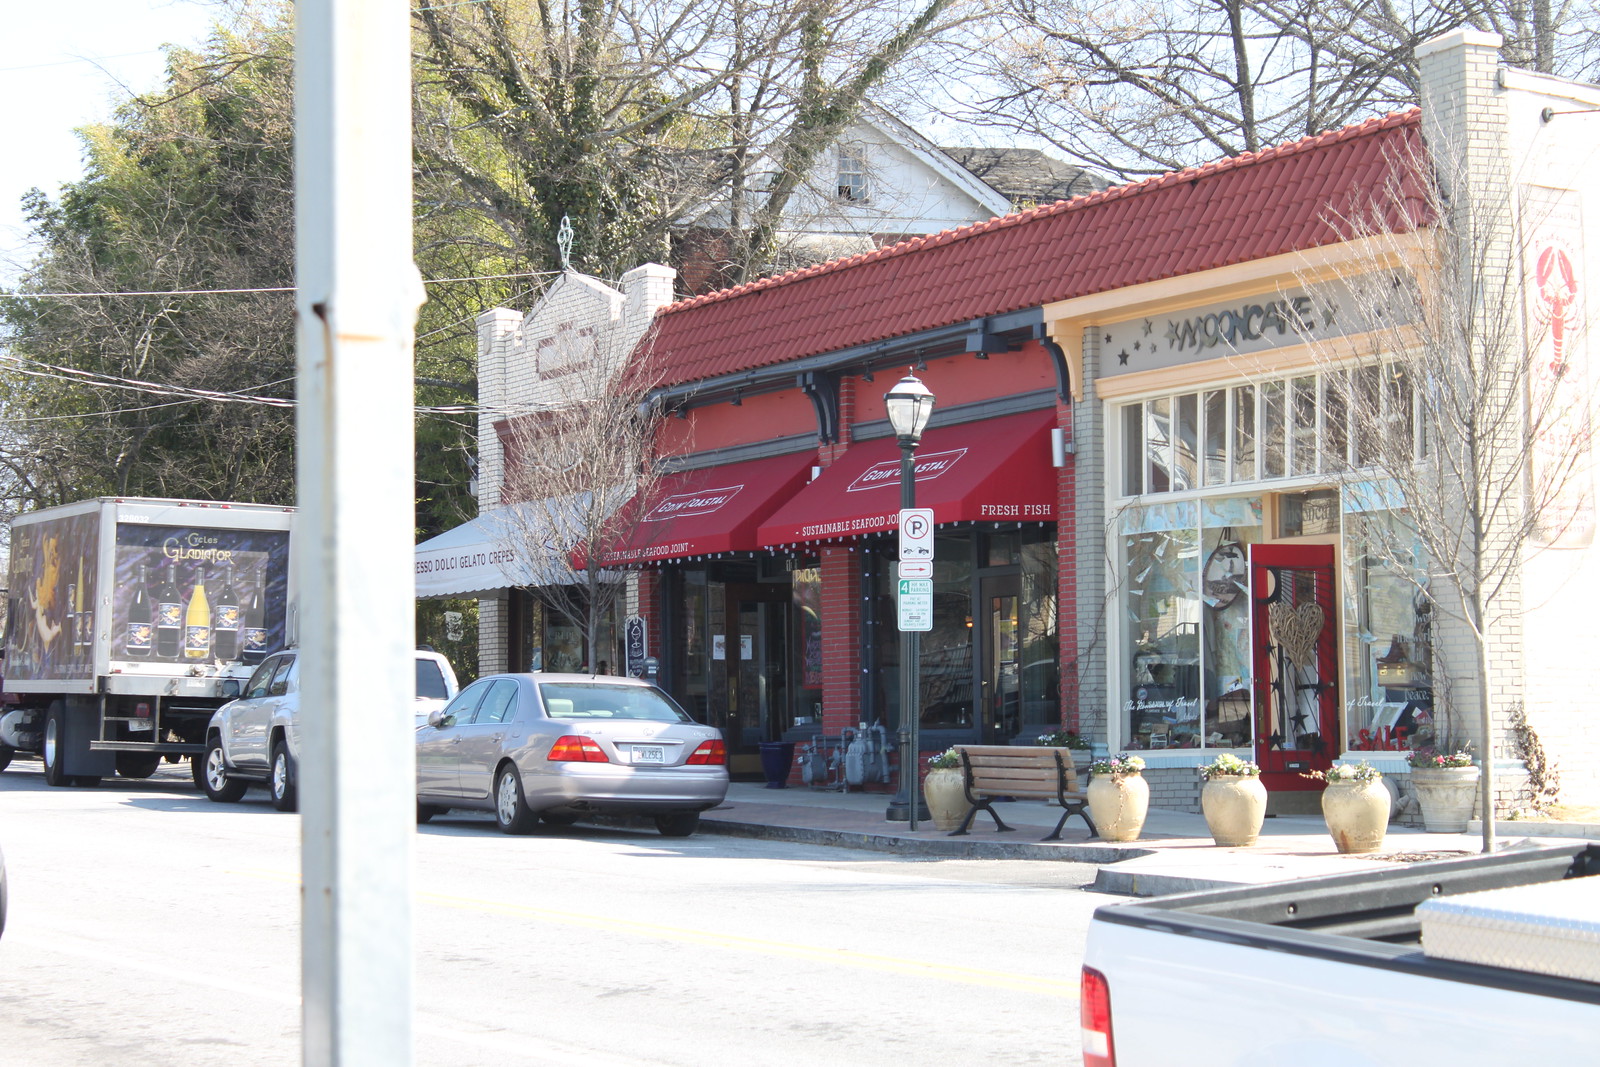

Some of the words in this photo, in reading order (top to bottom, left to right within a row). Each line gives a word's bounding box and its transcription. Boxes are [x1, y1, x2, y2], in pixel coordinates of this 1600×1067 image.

[893, 459, 949, 477] CASTAL
[981, 504, 1018, 516] FRESH
[1024, 504, 1051, 515] FISH
[802, 520, 850, 537] SUSTAINABLE
[851, 516, 885, 530] SEAFOOD
[886, 513, 899, 525] JOI
[670, 543, 689, 554] JOINT
[416, 561, 433, 574] ESSO
[435, 556, 458, 571] DOLCI
[460, 553, 486, 569] GELATO
[901, 582, 909, 594] 4
[1357, 695, 1385, 707] Travel
[1359, 725, 1410, 752] SALE
